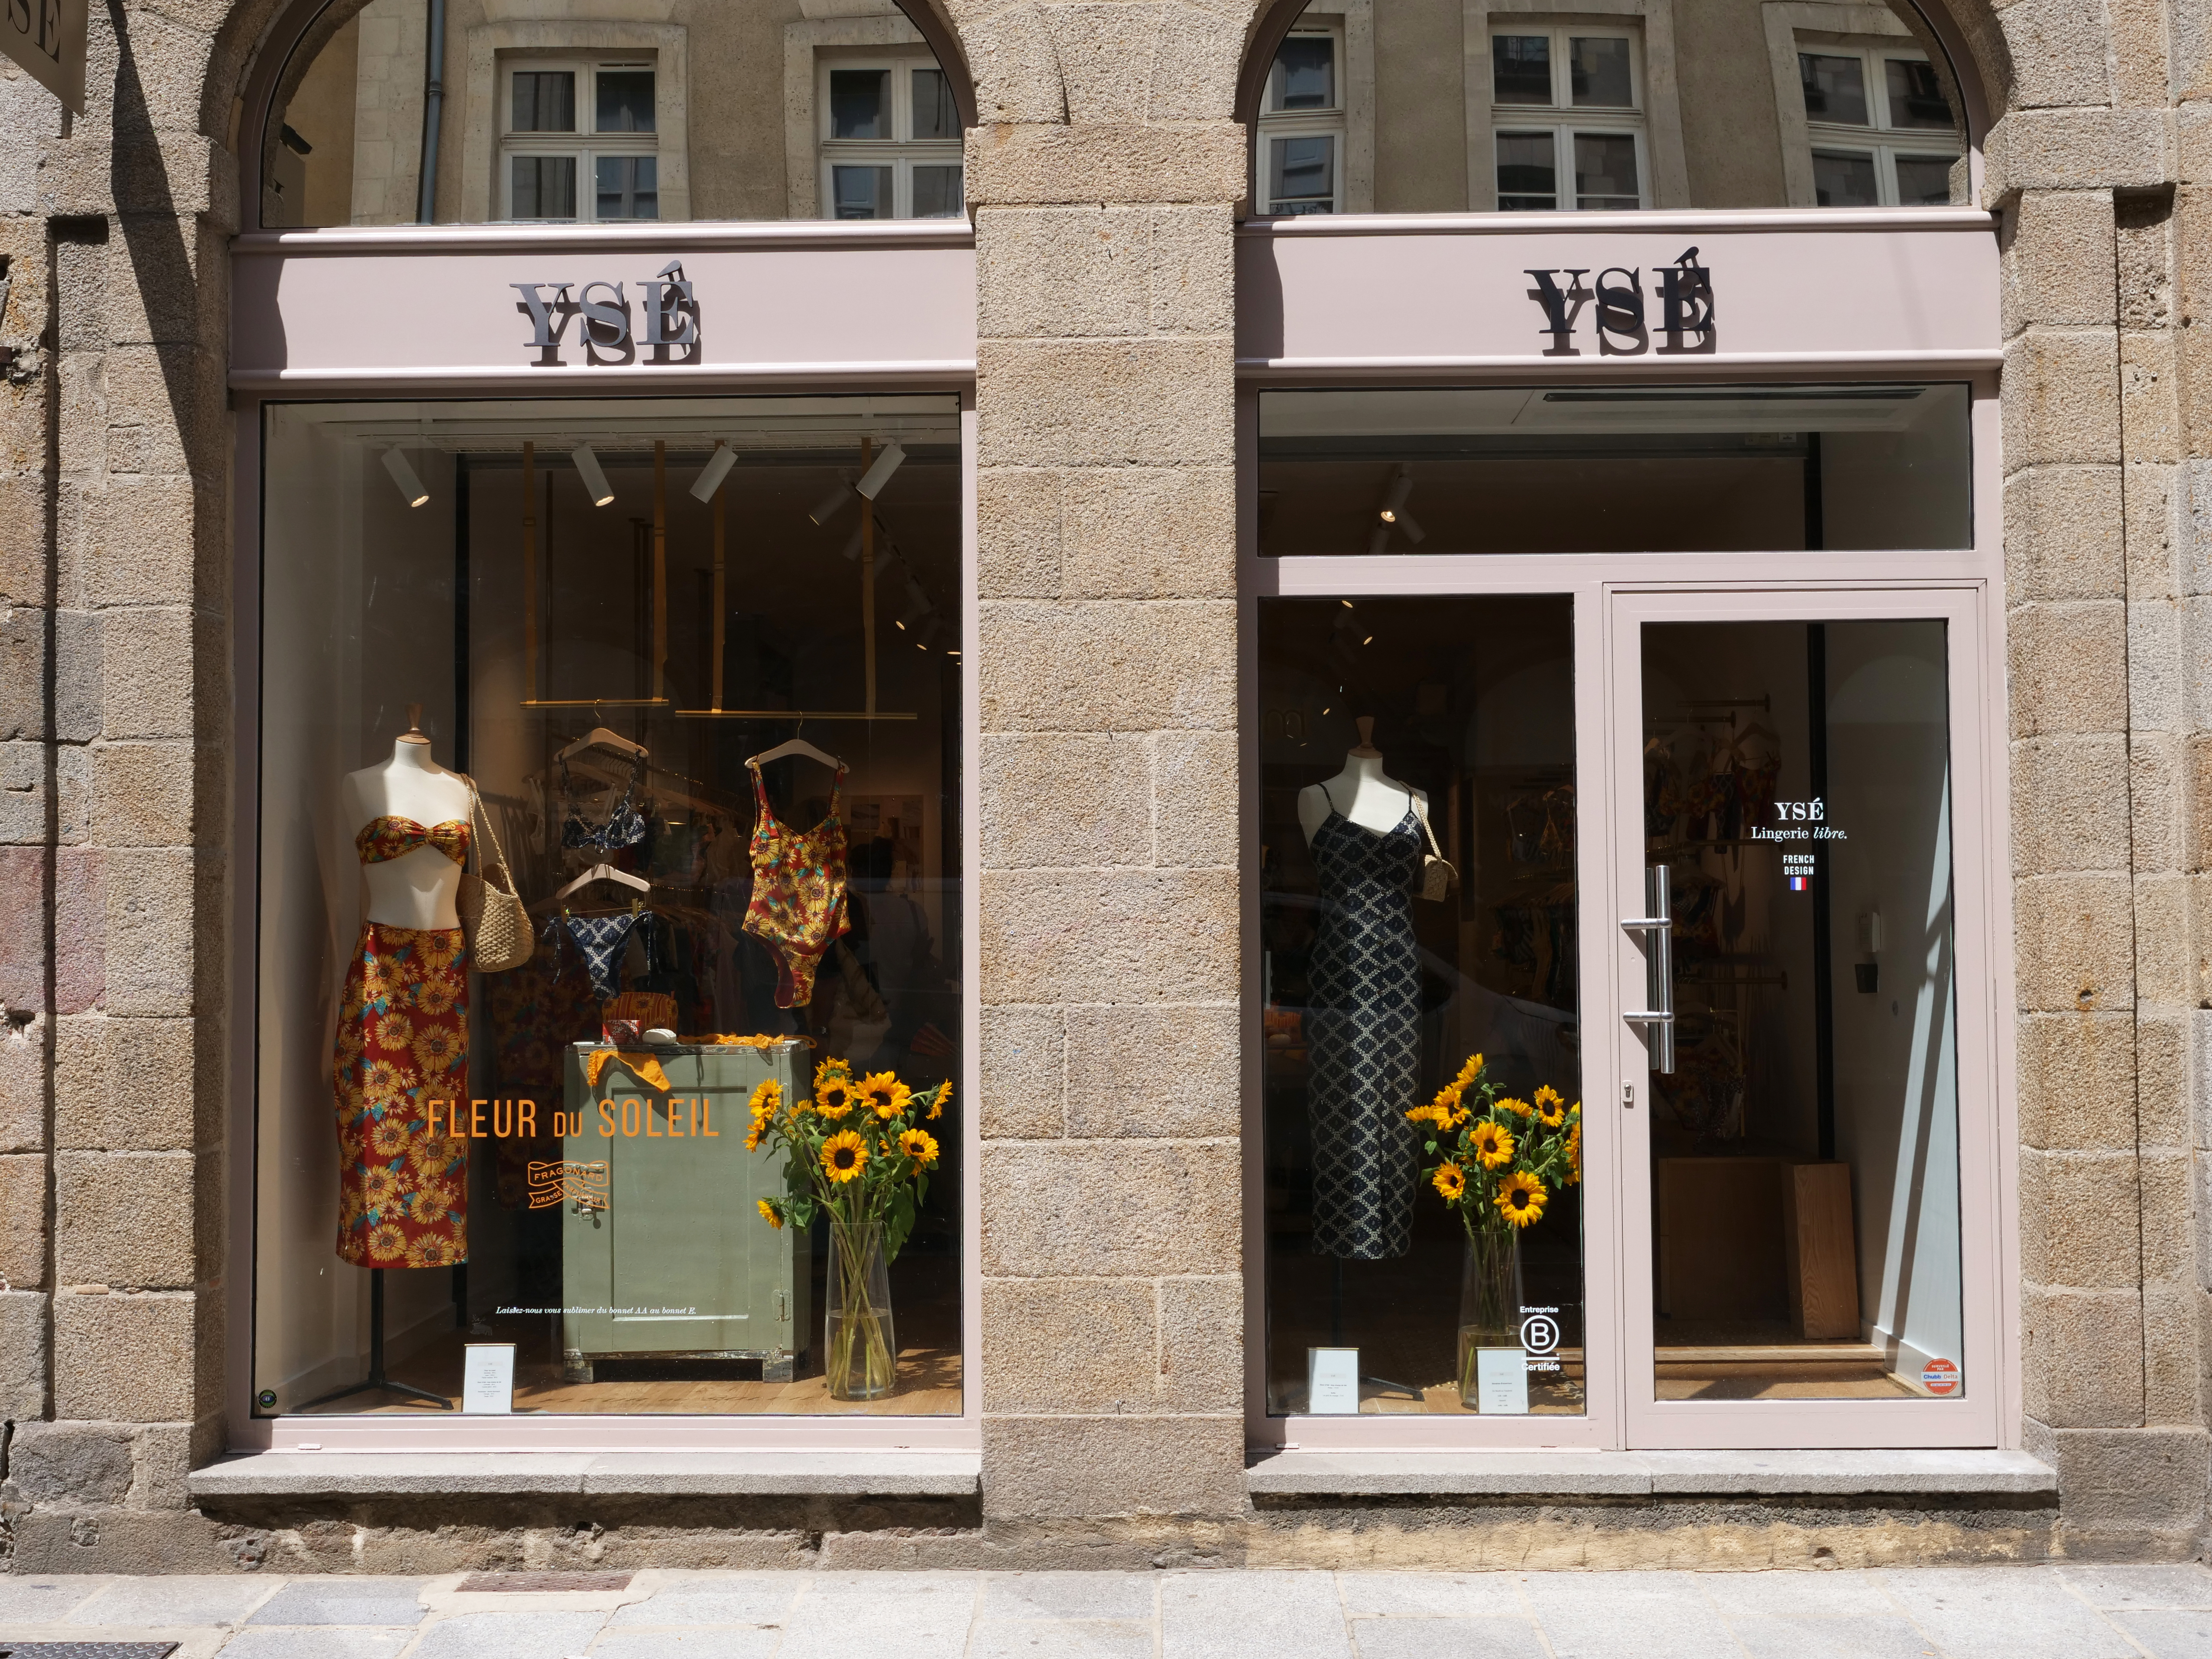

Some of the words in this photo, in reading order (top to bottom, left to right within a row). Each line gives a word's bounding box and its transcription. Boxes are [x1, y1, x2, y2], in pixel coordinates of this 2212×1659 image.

[1523, 246, 1712, 334] YSÉ
[509, 259, 694, 347] YSÉ
[1774, 797, 1823, 820] YSÉ
[1751, 826, 1809, 842] Lingerie
[1813, 826, 1847, 839] libre.
[1783, 855, 1814, 864] FRENCH
[1784, 866, 1814, 875] DESIGN
[428, 1099, 536, 1137] FLEUR
[554, 1111, 582, 1137] DU
[598, 1098, 719, 1137] SOLEIL
[534, 1166, 603, 1182] FRAGONARD
[535, 1190, 563, 1203] GRASSE
[1520, 1306, 1559, 1314] Entreprise
[1531, 1323, 1550, 1346] B
[1521, 1362, 1560, 1371] Certifiée
